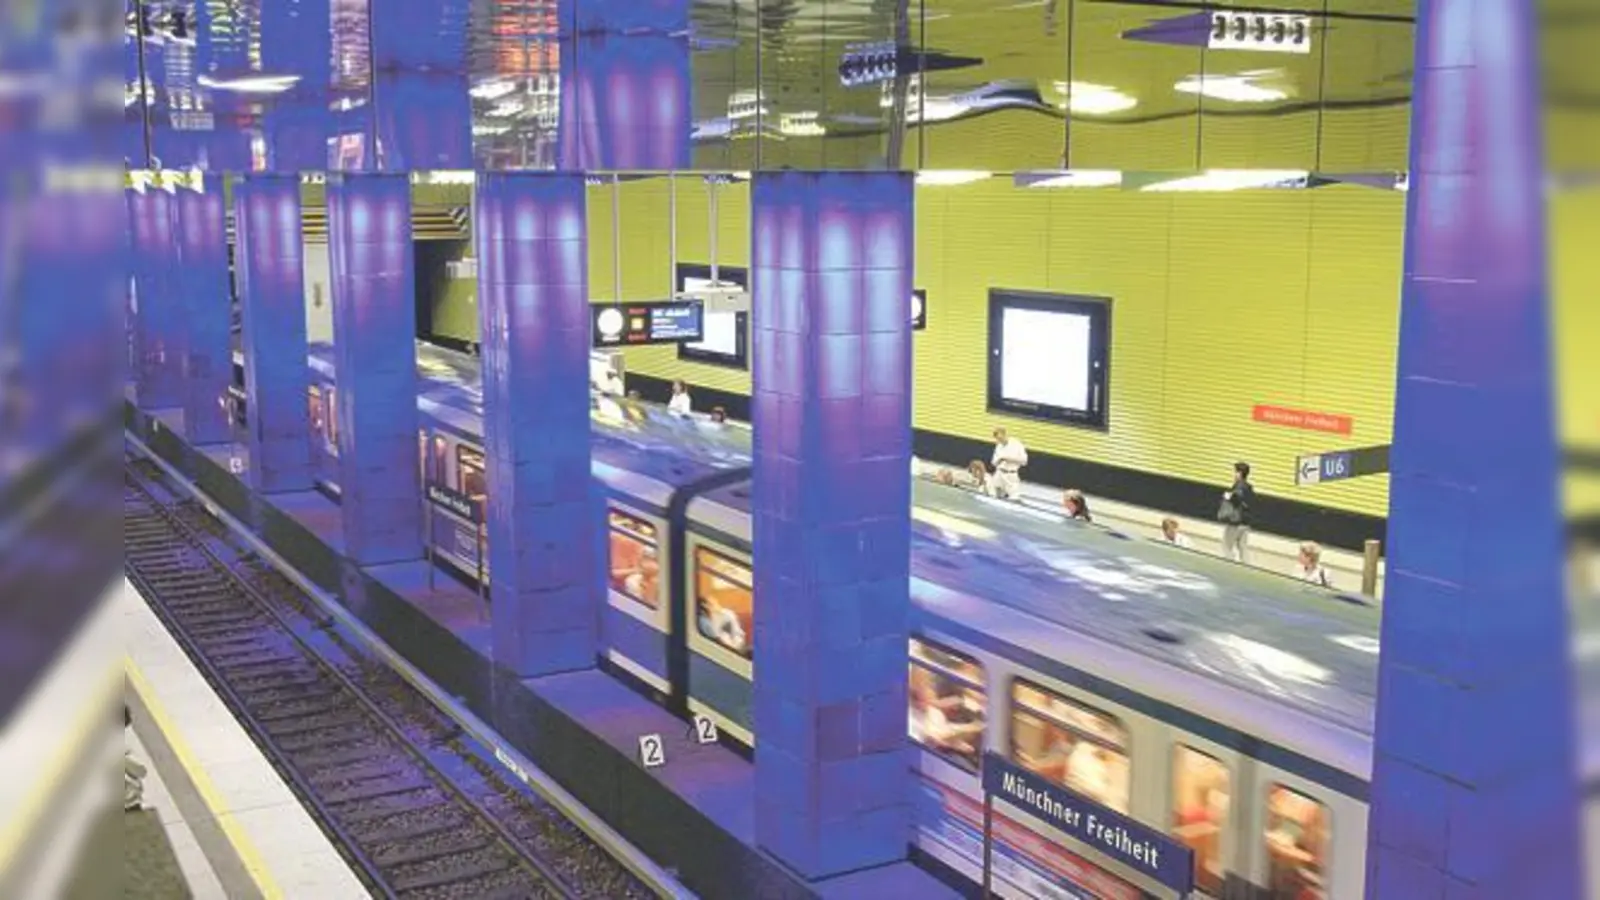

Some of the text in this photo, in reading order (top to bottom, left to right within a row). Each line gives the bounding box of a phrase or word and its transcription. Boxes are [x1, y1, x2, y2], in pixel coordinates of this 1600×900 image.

[1325, 458, 1345, 476] U6
[699, 717, 715, 739] 2
[644, 738, 661, 763] 2
[1002, 771, 1159, 869] Münchner Freiheit
